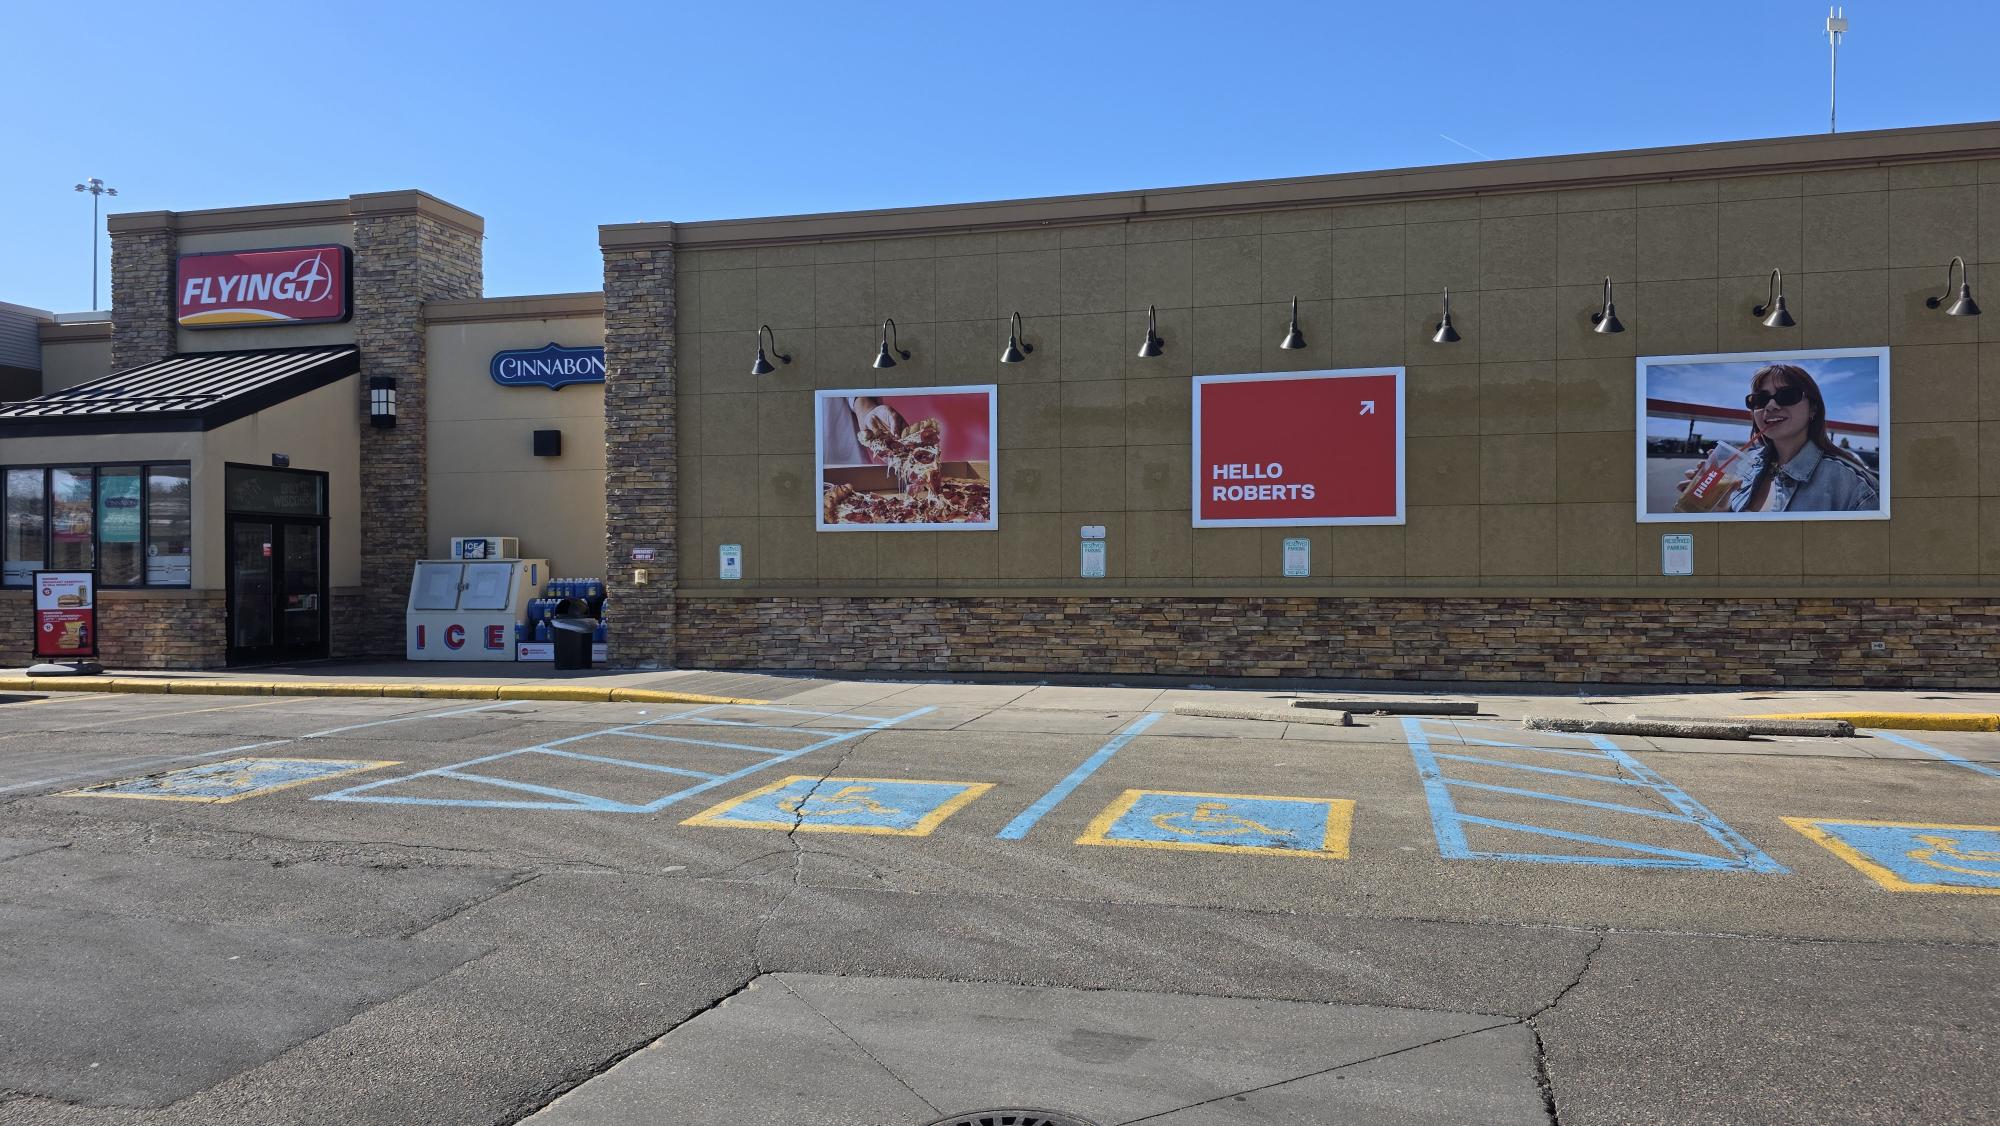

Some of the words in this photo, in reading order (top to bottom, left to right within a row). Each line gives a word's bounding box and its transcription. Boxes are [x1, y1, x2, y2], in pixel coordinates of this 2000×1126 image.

[183, 271, 297, 305] FLYING
[500, 355, 605, 379] CINNABON
[1212, 462, 1283, 480] HELLO
[1212, 483, 1316, 502] ROBERTS
[1693, 470, 1718, 499] pilot
[464, 542, 480, 551] ICE
[417, 624, 505, 650] ICE
